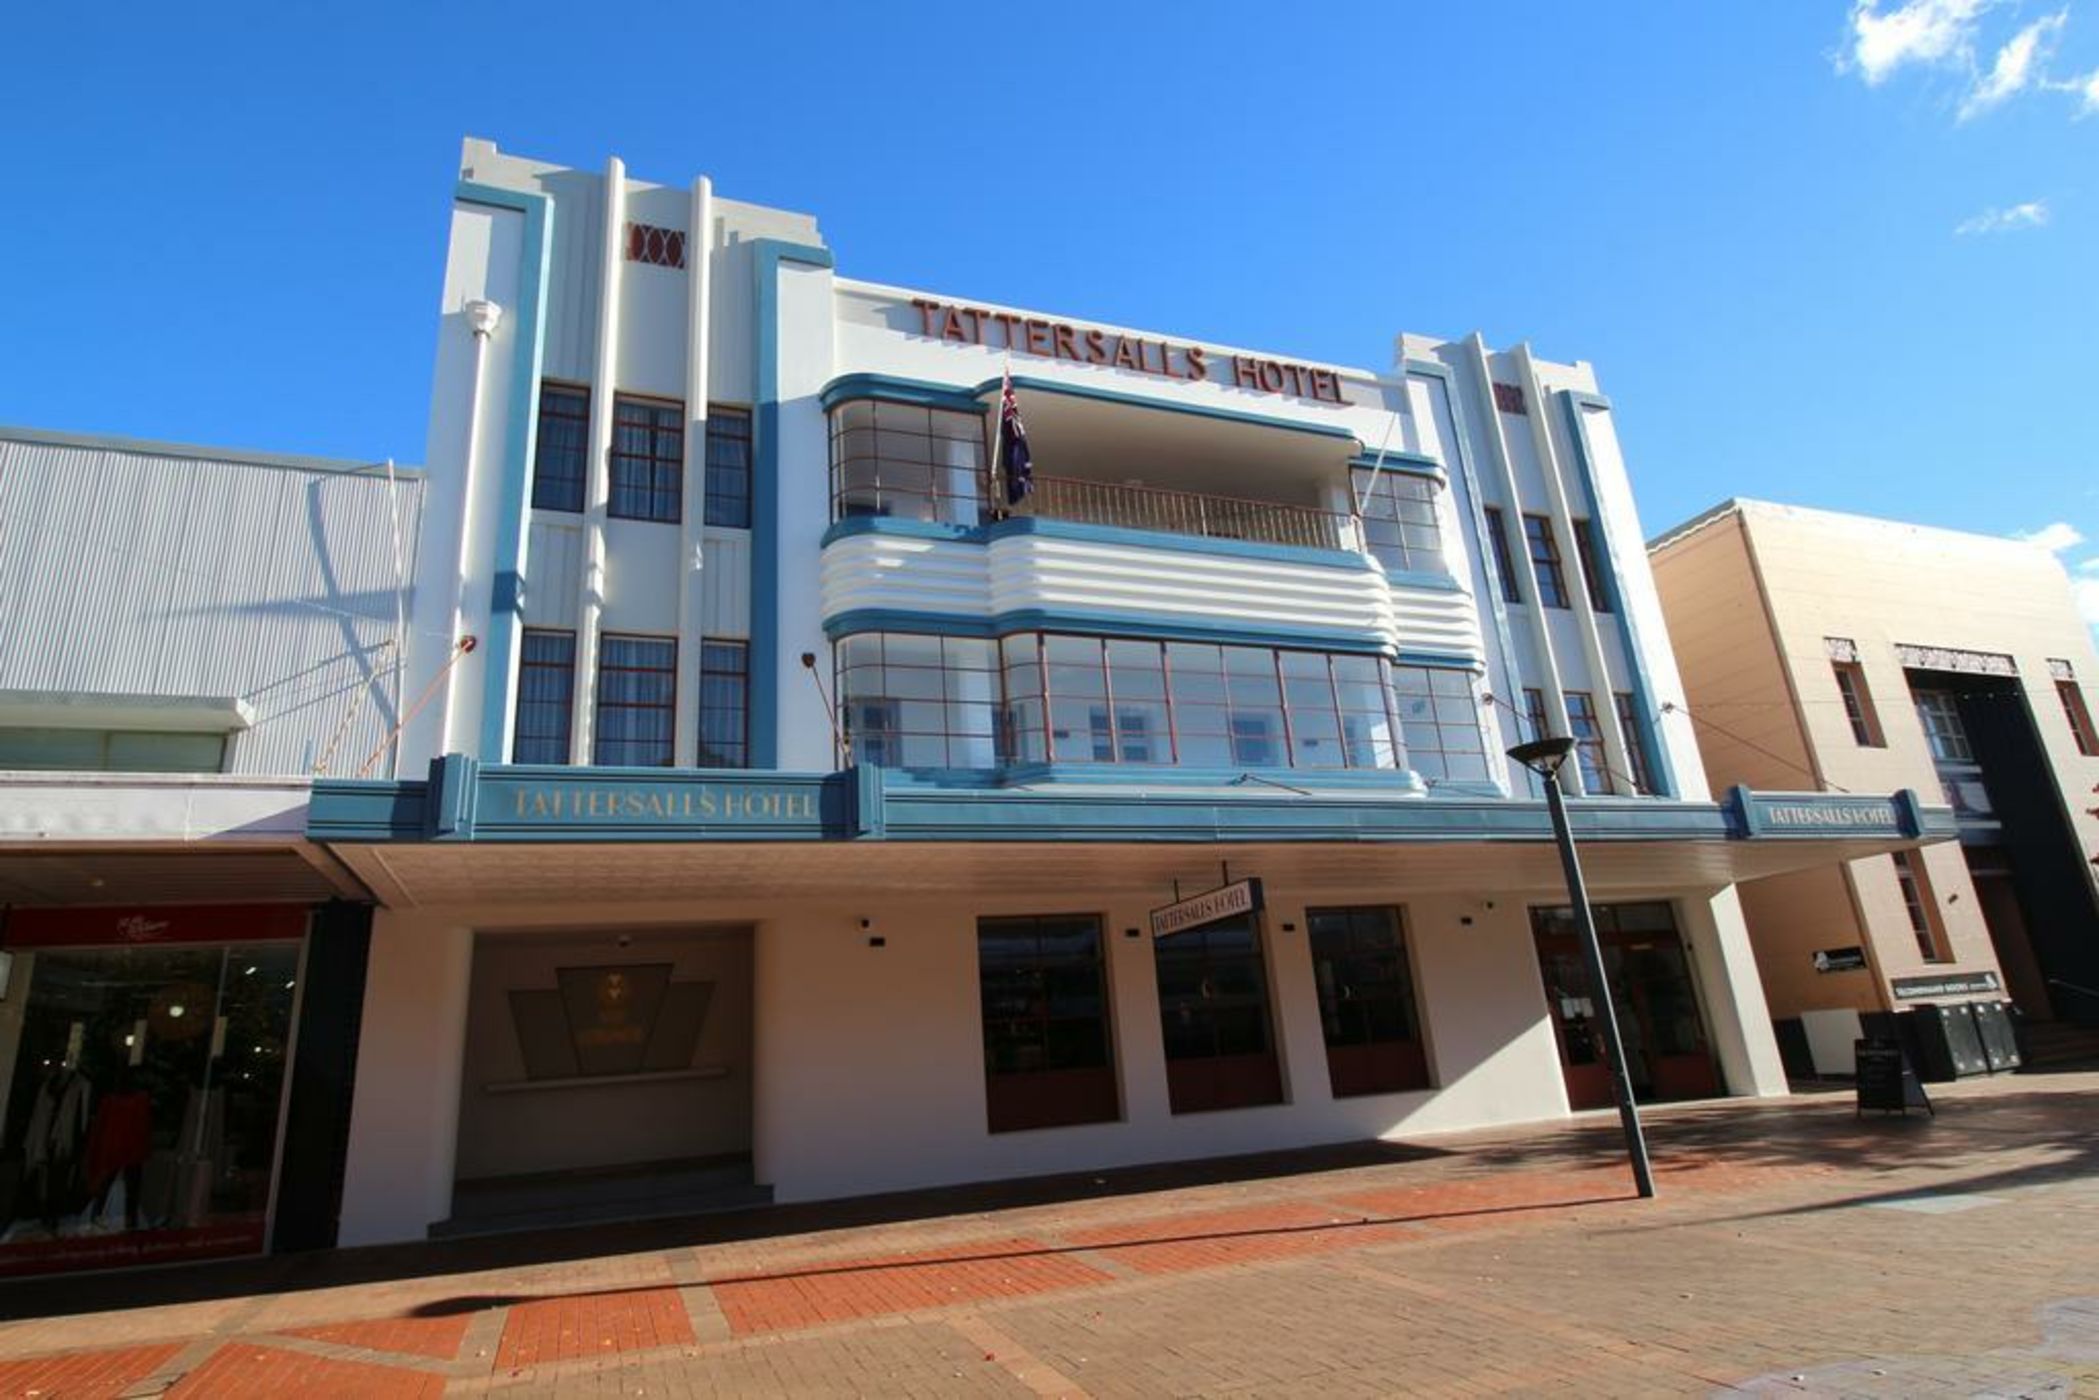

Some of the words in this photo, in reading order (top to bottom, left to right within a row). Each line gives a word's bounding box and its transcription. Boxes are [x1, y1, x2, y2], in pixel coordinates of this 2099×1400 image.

[911, 298, 1206, 382] TATTERSALLS
[1232, 354, 1354, 406] HOTEL
[724, 789, 818, 820] HOTEL
